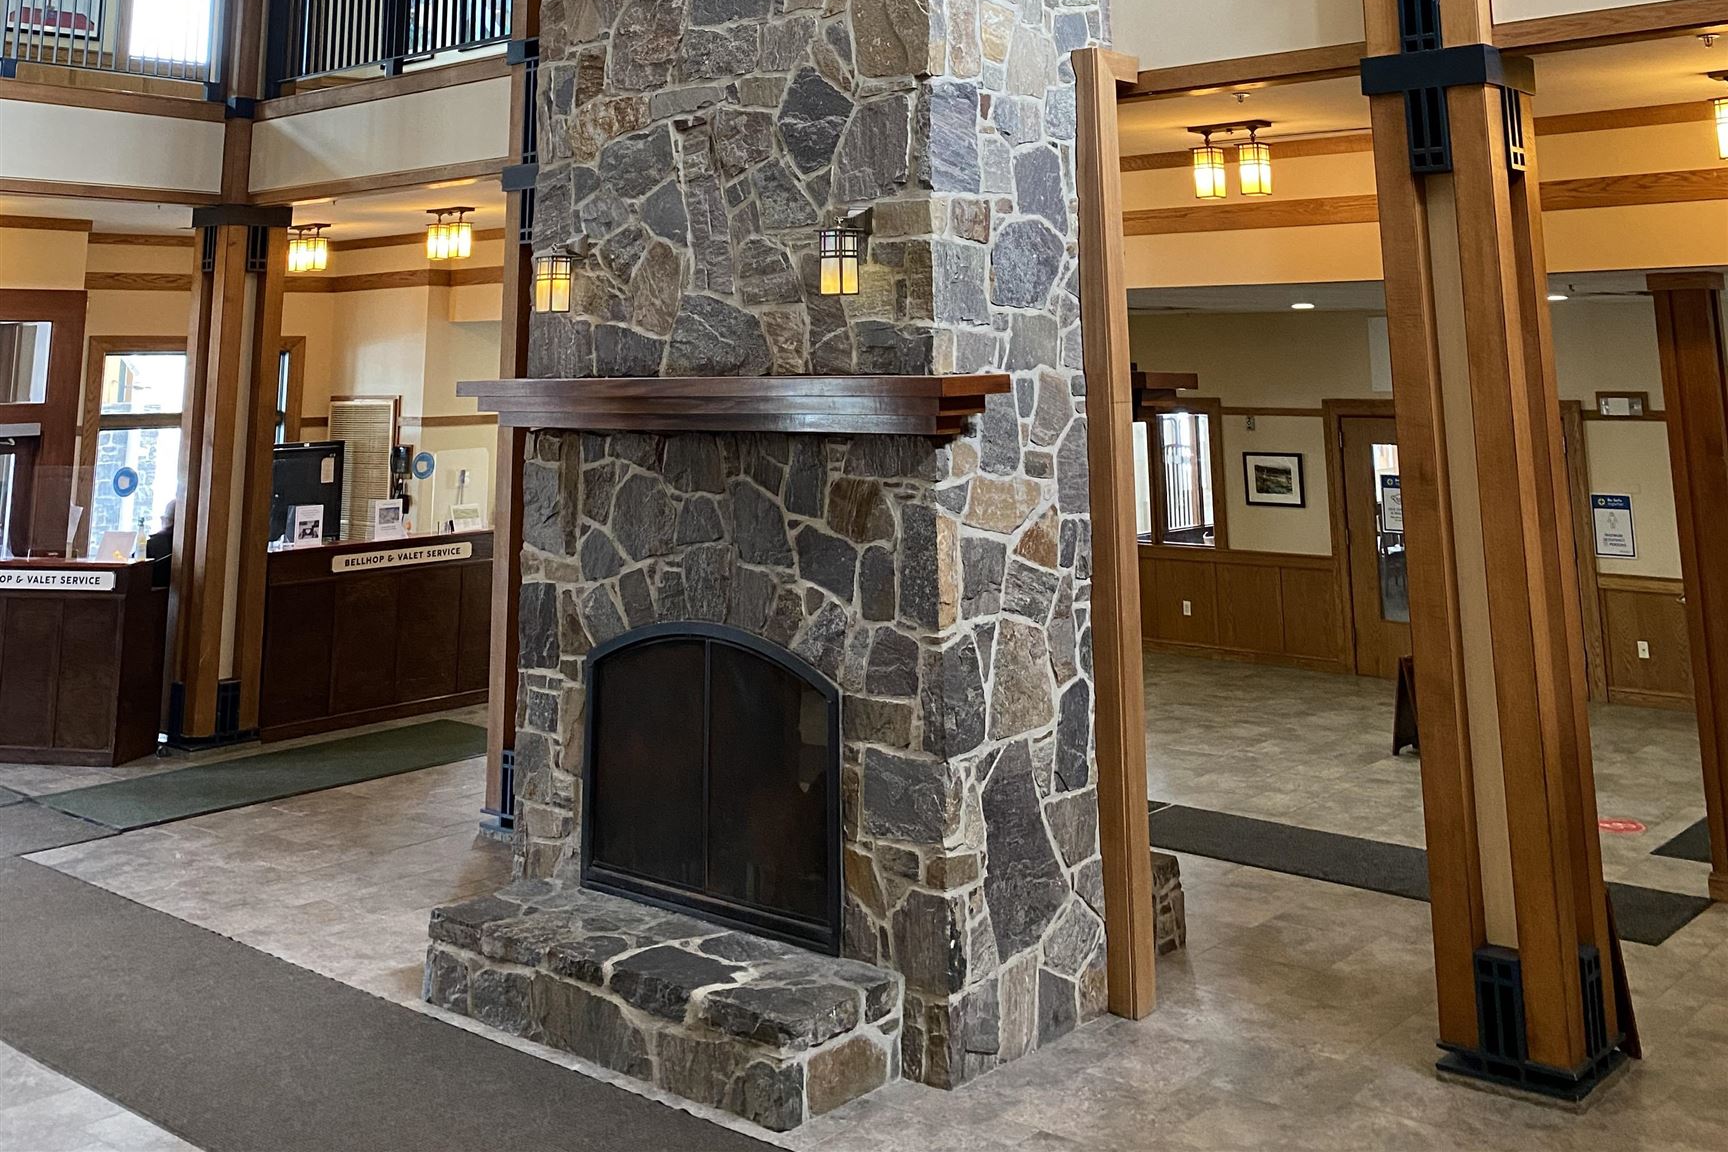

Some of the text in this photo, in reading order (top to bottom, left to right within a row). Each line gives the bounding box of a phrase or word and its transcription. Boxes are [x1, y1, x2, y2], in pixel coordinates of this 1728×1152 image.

[344, 555, 384, 567] BELLHOP
[398, 550, 423, 561] VALET
[427, 547, 461, 558] SERVICE
[16, 575, 23, 584] &
[27, 575, 57, 584] VALET
[60, 576, 101, 585] SERVICE
